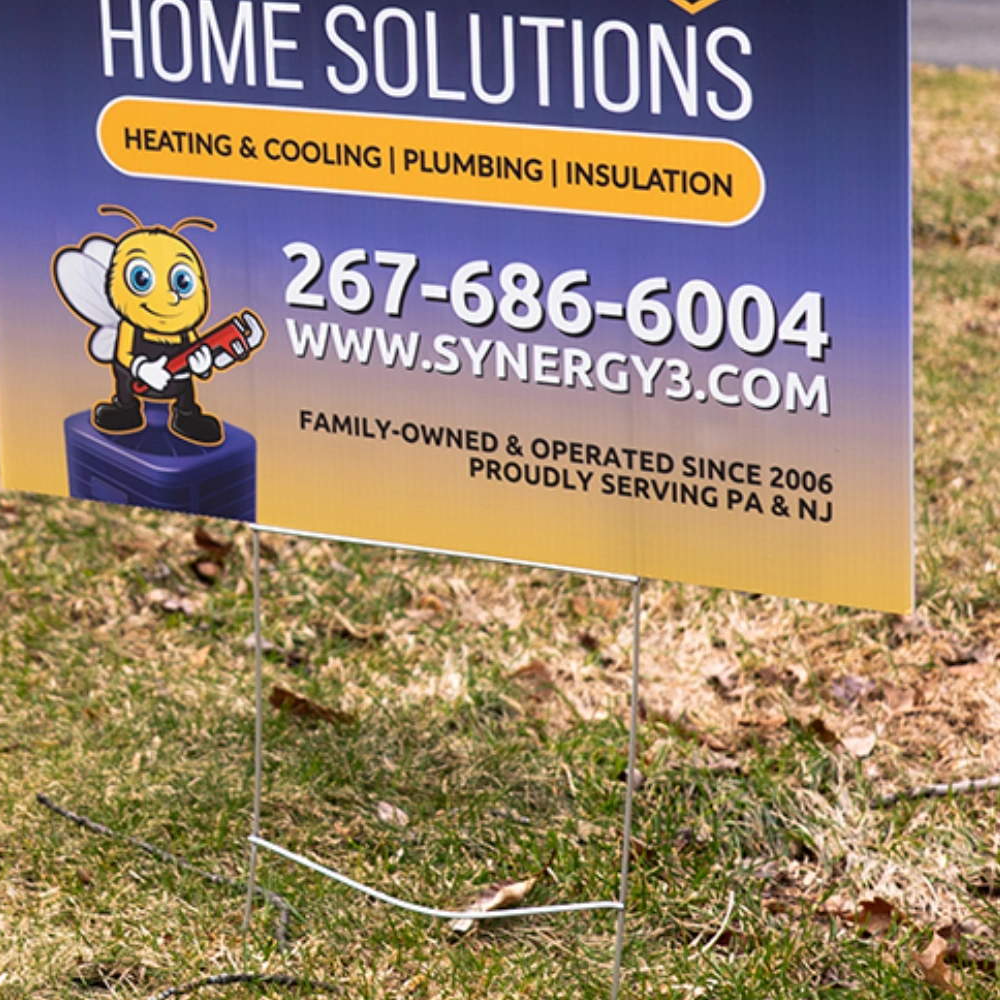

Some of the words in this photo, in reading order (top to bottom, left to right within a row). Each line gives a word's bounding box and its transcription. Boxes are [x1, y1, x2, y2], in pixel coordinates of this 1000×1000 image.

[324, 4, 755, 122] SOLUTIONS
[124, 126, 233, 158] HEATING
[238, 135, 259, 160] &
[263, 137, 383, 170] COOLING
[403, 148, 544, 183] PLUMBING
[565, 160, 733, 199] INSULATION
[282, 241, 831, 360] 267-686-6004
[284, 316, 831, 416] WWW.SYNERGY3.COM
[299, 409, 500, 454] FAMILY-OWNED
[504, 433, 525, 458] &
[529, 436, 676, 475] OPERATED
[681, 454, 763, 487] SINCE
[769, 465, 834, 496] 2006
[468, 456, 595, 493] PROUDLY
[600, 472, 719, 509] SERVING
[726, 487, 764, 515] PA
[770, 493, 791, 519] &
[797, 496, 834, 524] NJ
